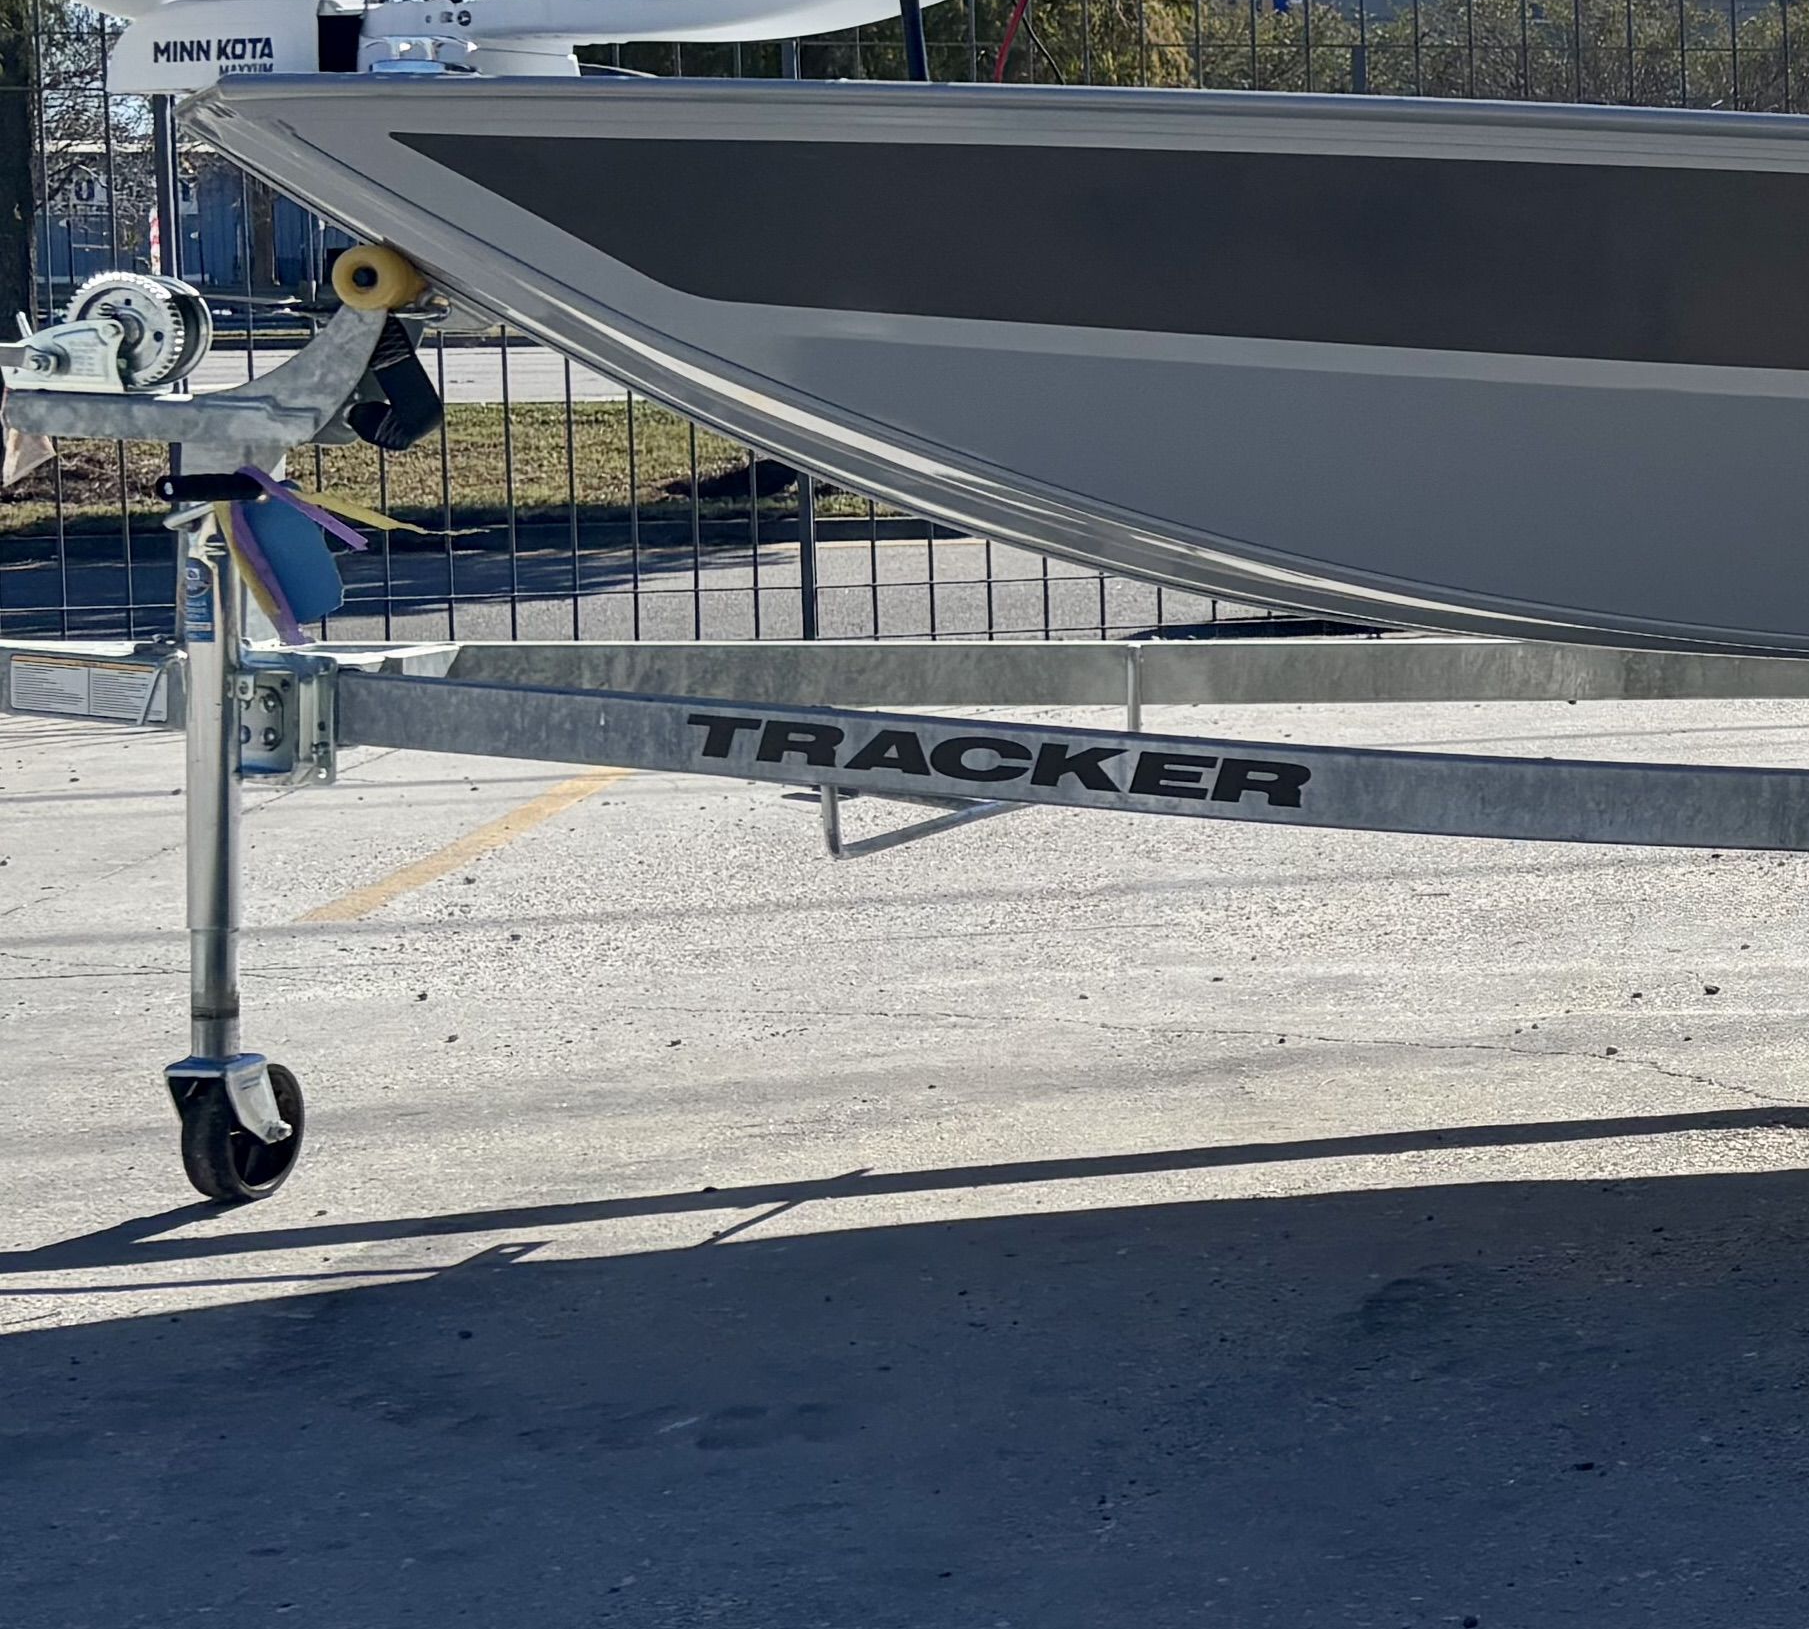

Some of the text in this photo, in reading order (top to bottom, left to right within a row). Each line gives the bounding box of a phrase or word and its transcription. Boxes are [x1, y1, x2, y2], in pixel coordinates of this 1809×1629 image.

[153, 37, 274, 63] MINN KOTA
[687, 714, 1312, 808] TRACKER
